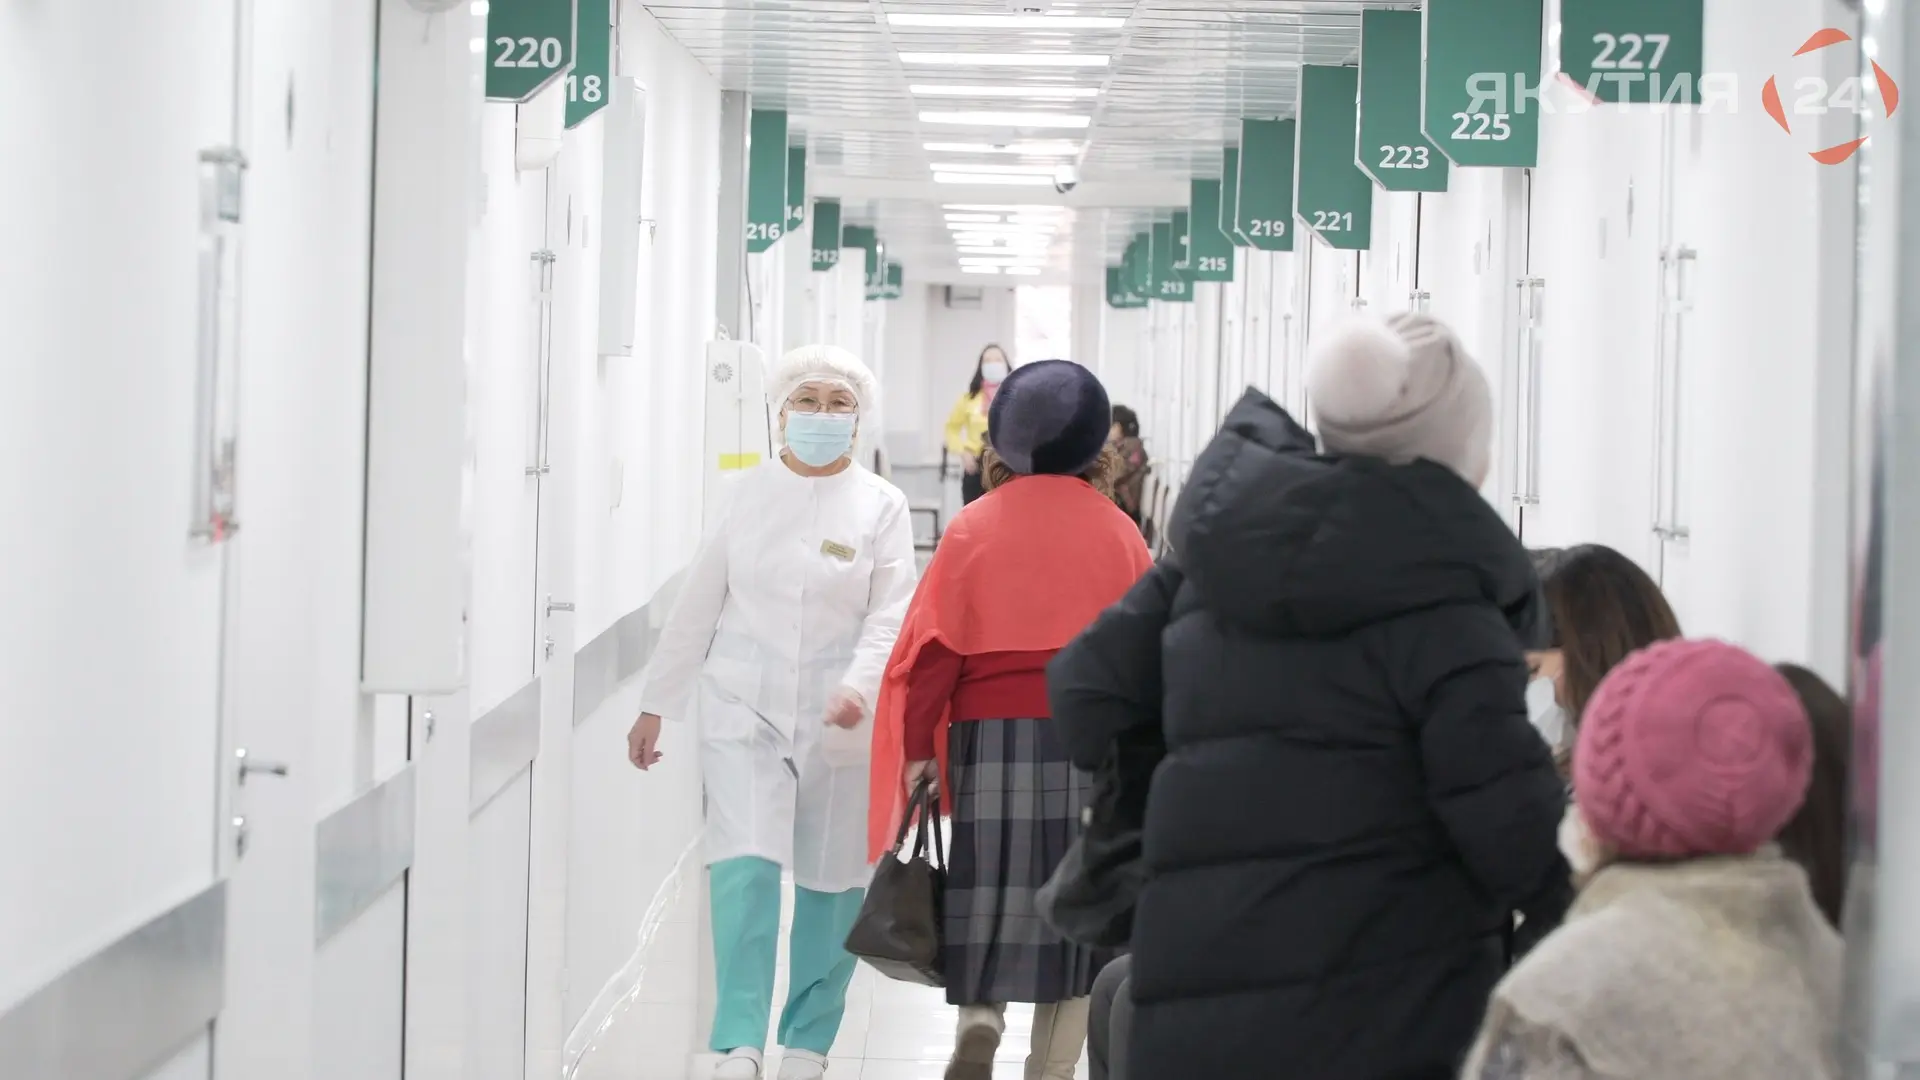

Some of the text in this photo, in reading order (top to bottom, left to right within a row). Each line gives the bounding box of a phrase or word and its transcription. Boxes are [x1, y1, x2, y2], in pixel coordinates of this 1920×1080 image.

[494, 37, 562, 68] 220
[1591, 33, 1670, 69] 227
[566, 75, 602, 102] 18
[1451, 112, 1511, 140] 225
[1379, 145, 1429, 169] 223
[787, 205, 803, 220] 14
[1312, 211, 1353, 231] 221
[747, 223, 780, 239] 216
[1250, 220, 1285, 237] 219
[812, 250, 839, 263] 212
[1198, 256, 1227, 271] 215
